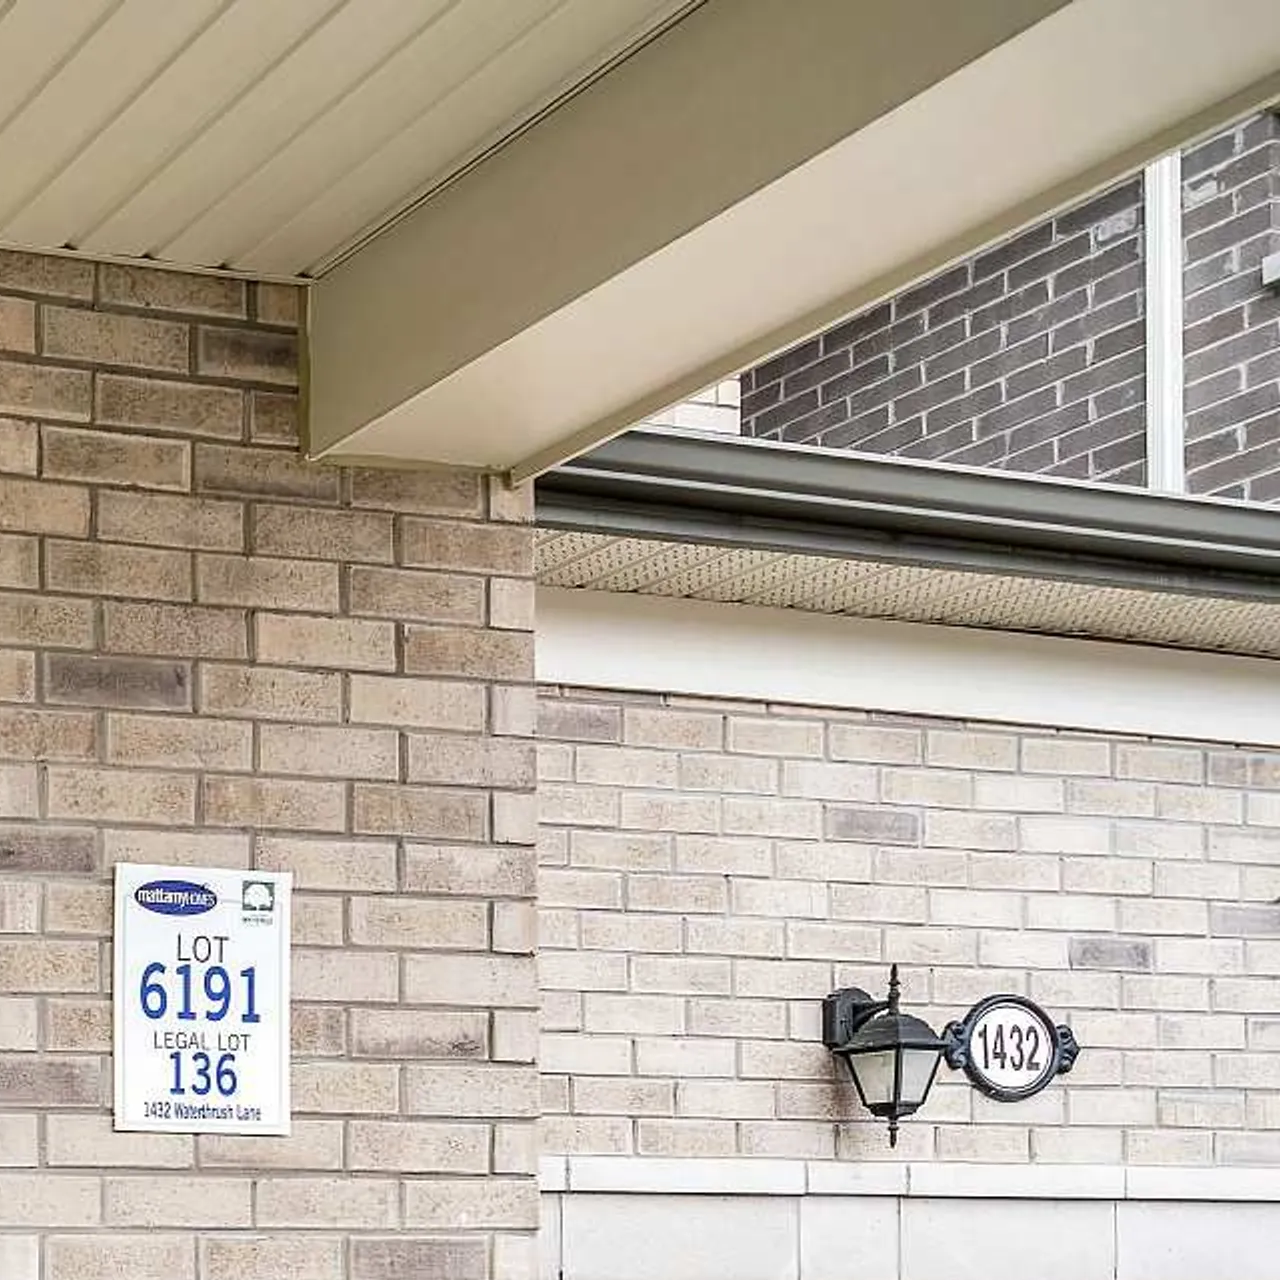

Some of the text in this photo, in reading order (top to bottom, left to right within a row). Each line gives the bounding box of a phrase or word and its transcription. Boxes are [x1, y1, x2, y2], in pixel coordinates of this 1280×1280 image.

[177, 933, 229, 963] LOT
[140, 962, 261, 1023] 6191
[153, 1031, 252, 1052] LEGAL LOT
[977, 1023, 1041, 1072] 1432
[169, 1051, 238, 1097] 136
[143, 1101, 172, 1120] 1432
[236, 1103, 262, 1121] Lane
